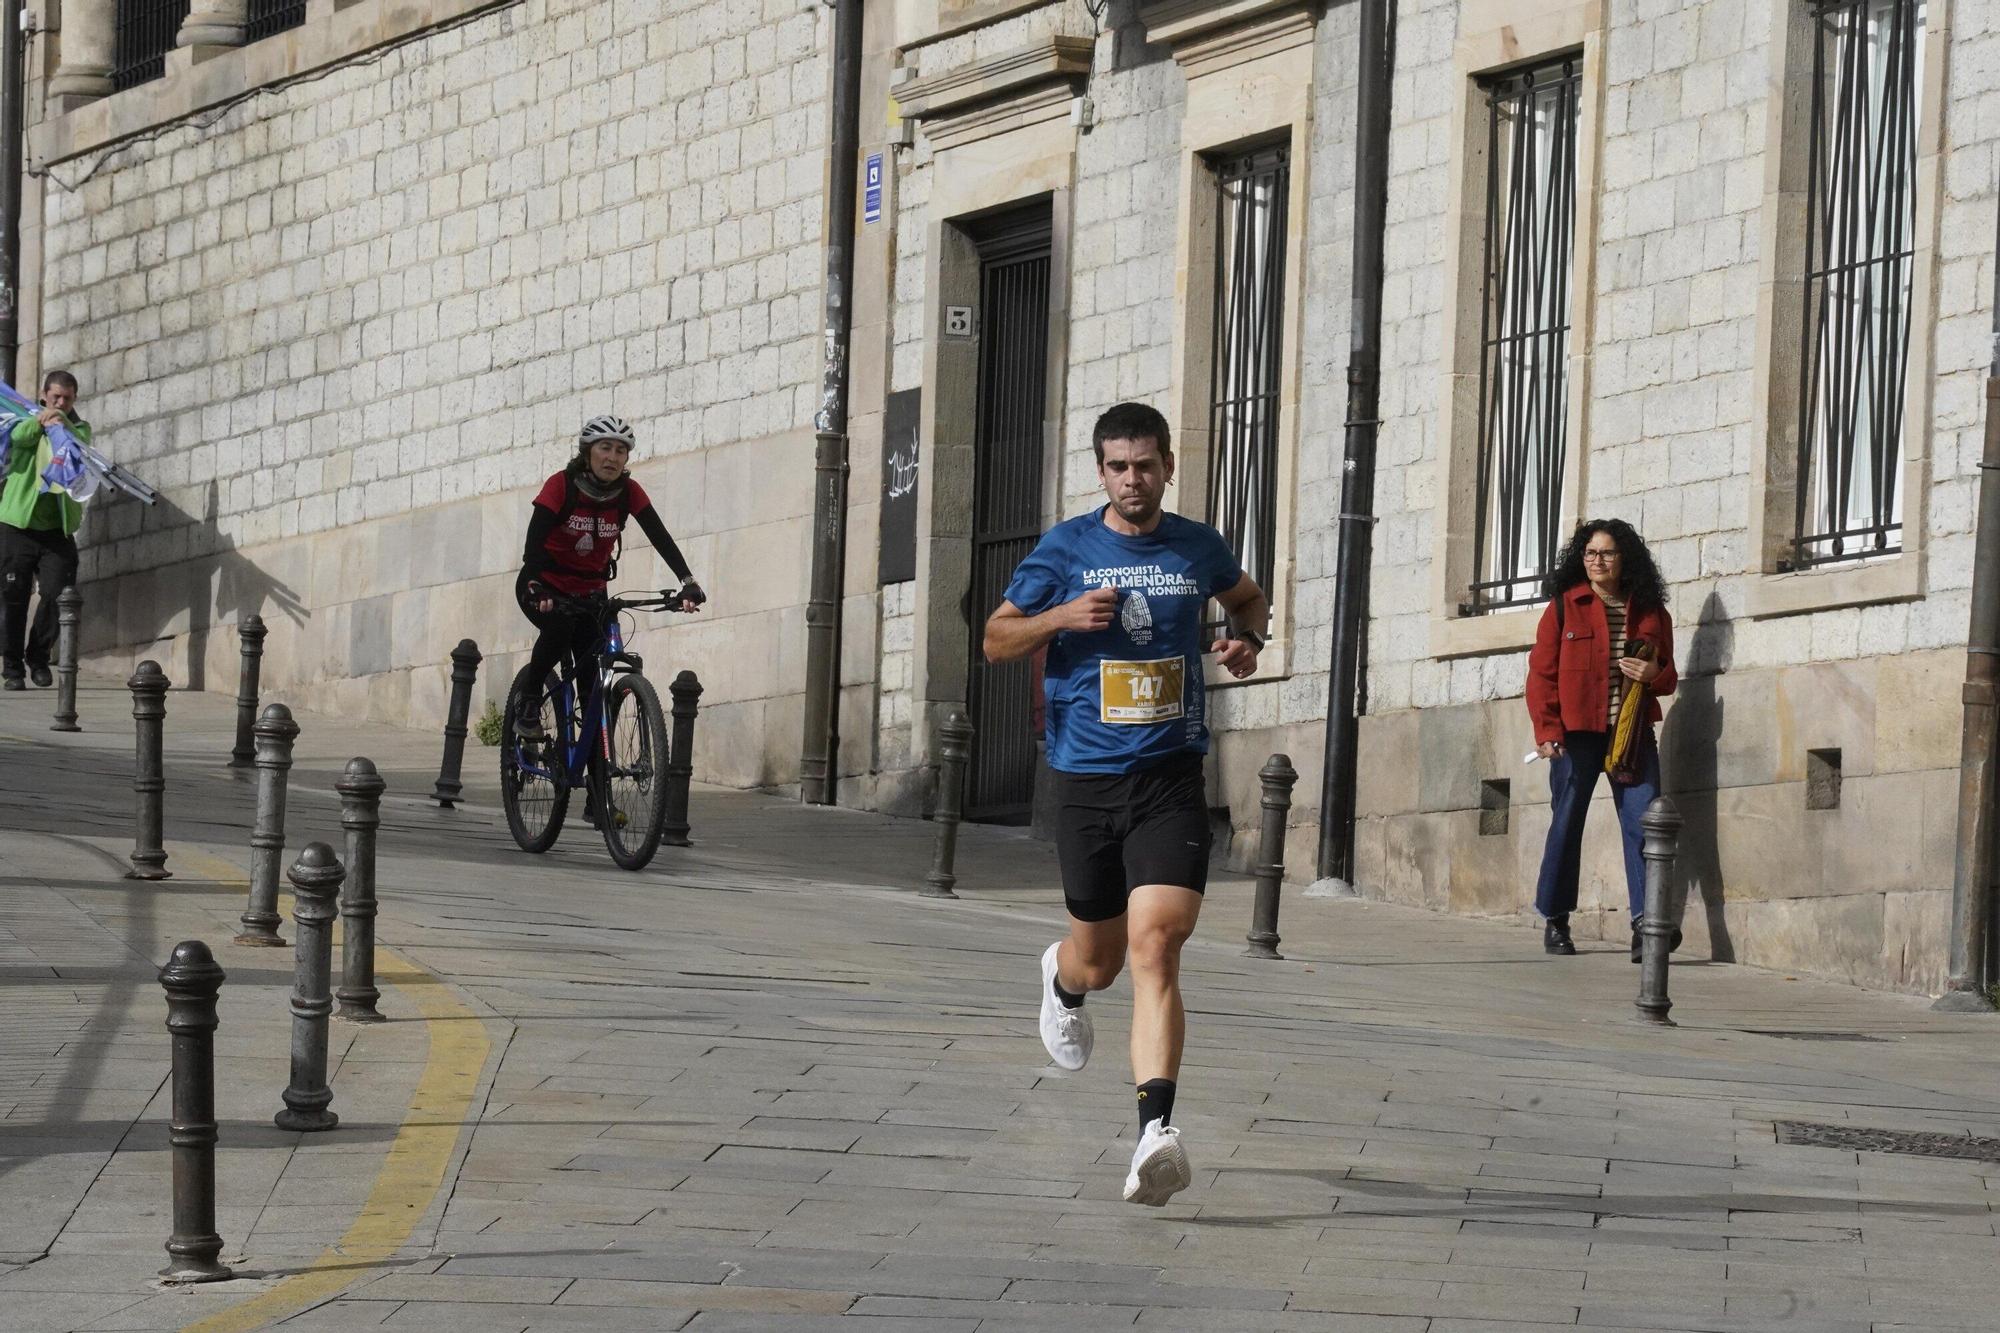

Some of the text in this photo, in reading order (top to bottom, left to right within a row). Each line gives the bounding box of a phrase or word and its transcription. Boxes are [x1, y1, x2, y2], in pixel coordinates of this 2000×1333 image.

[569, 515, 605, 523] CONQUTA
[1083, 565, 1162, 579] LA CONQUISTA
[1100, 573, 1186, 588] ALMENDRA
[1147, 585, 1199, 596] KONKISTA
[1128, 677, 1163, 699] 147
